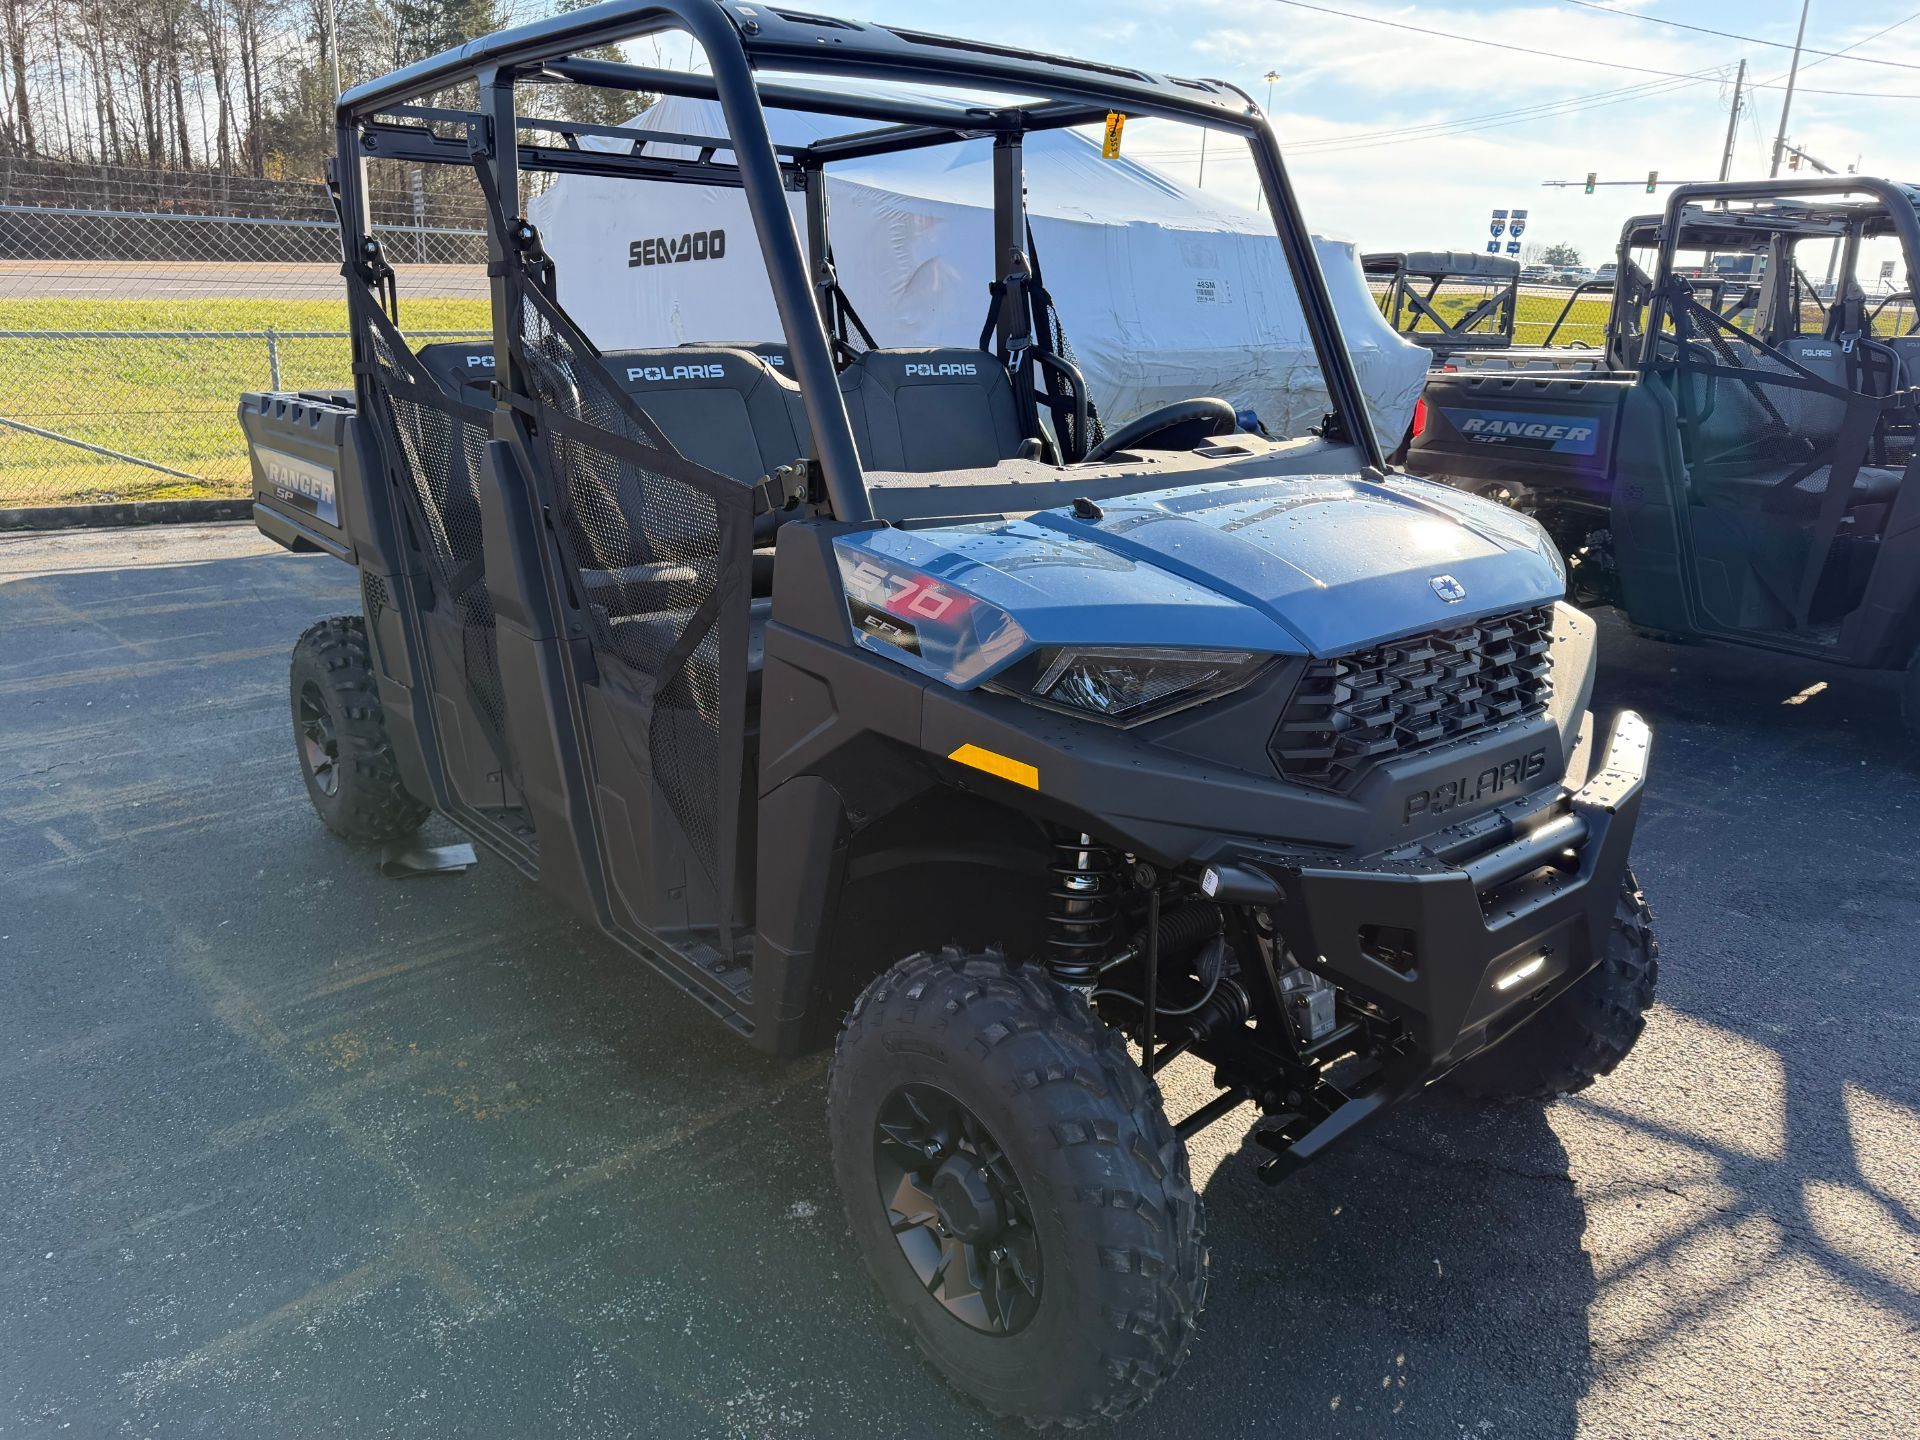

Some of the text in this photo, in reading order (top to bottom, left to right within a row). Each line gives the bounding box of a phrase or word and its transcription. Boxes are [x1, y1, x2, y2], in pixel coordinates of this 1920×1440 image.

[1491, 224, 1504, 235] 75
[1511, 224, 1524, 235] 75
[1801, 348, 1832, 358] POLARIS
[626, 364, 725, 381] POLARIS
[905, 363, 977, 377] POLARIS
[1462, 418, 1592, 441] RANGER
[1471, 434, 1507, 443] SP
[268, 462, 334, 505] RANGER
[276, 487, 294, 501] SP
[847, 561, 953, 620] 570
[863, 614, 902, 637] EFI
[1402, 747, 1547, 827] POLARIS
